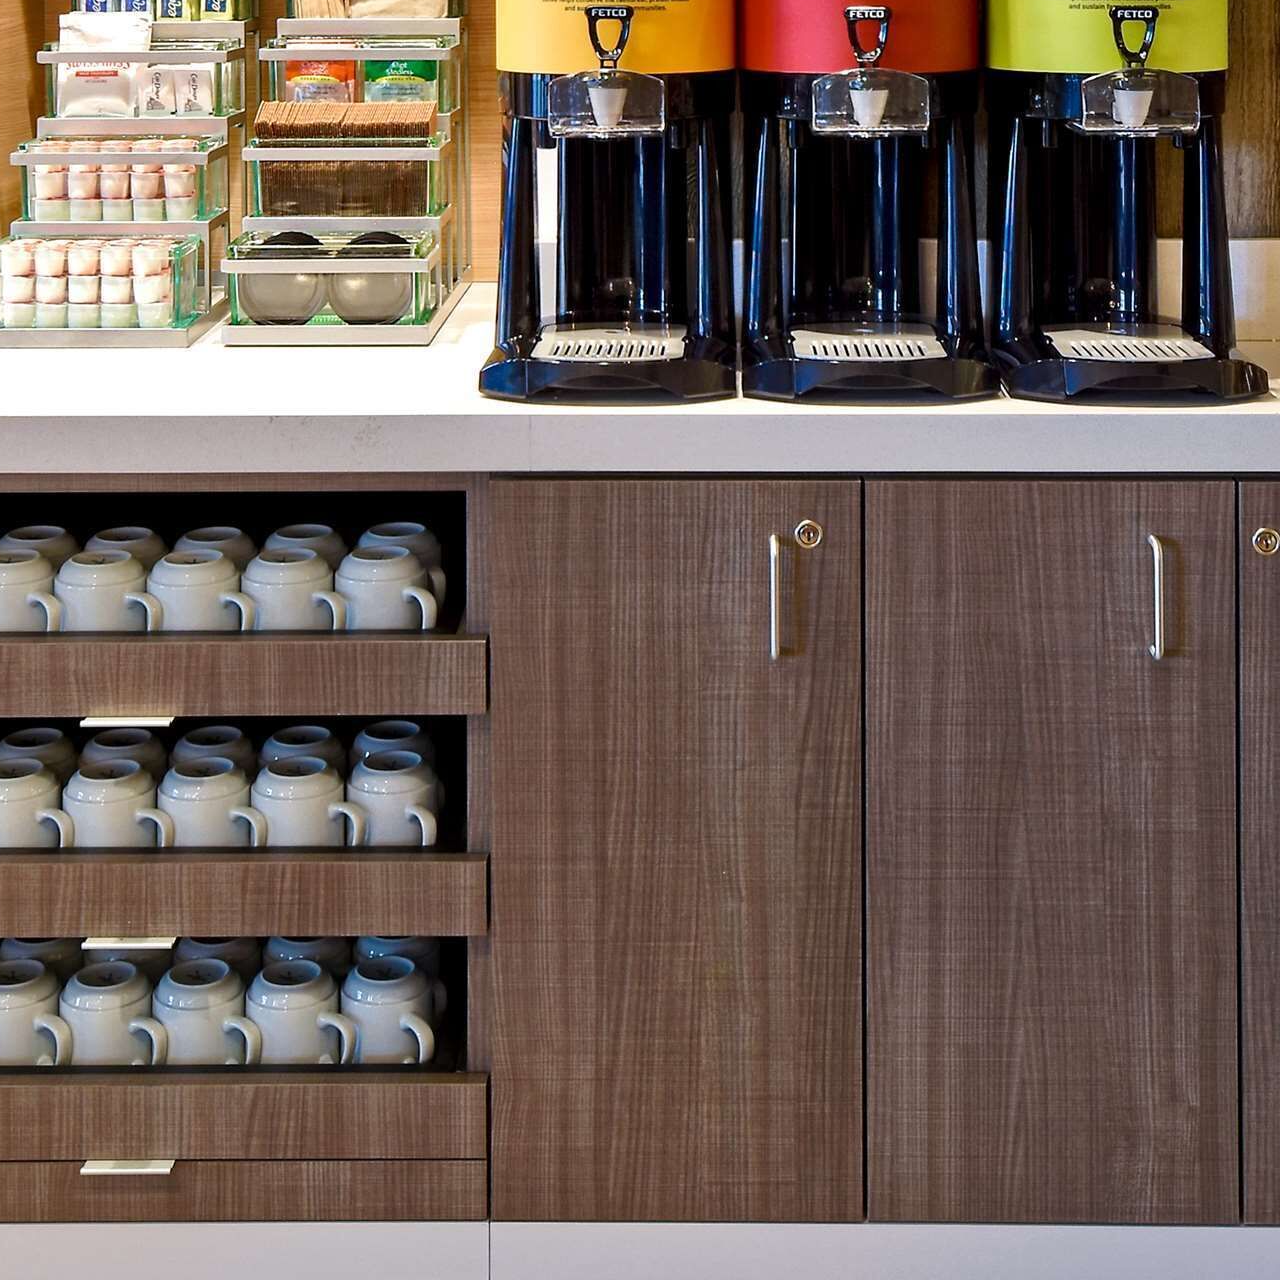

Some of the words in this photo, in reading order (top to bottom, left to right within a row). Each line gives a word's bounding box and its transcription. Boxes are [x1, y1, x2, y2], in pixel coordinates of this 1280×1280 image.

[591, 9, 627, 17] FETCO
[850, 10, 885, 18] FETCO
[1117, 10, 1153, 18] FETCO
